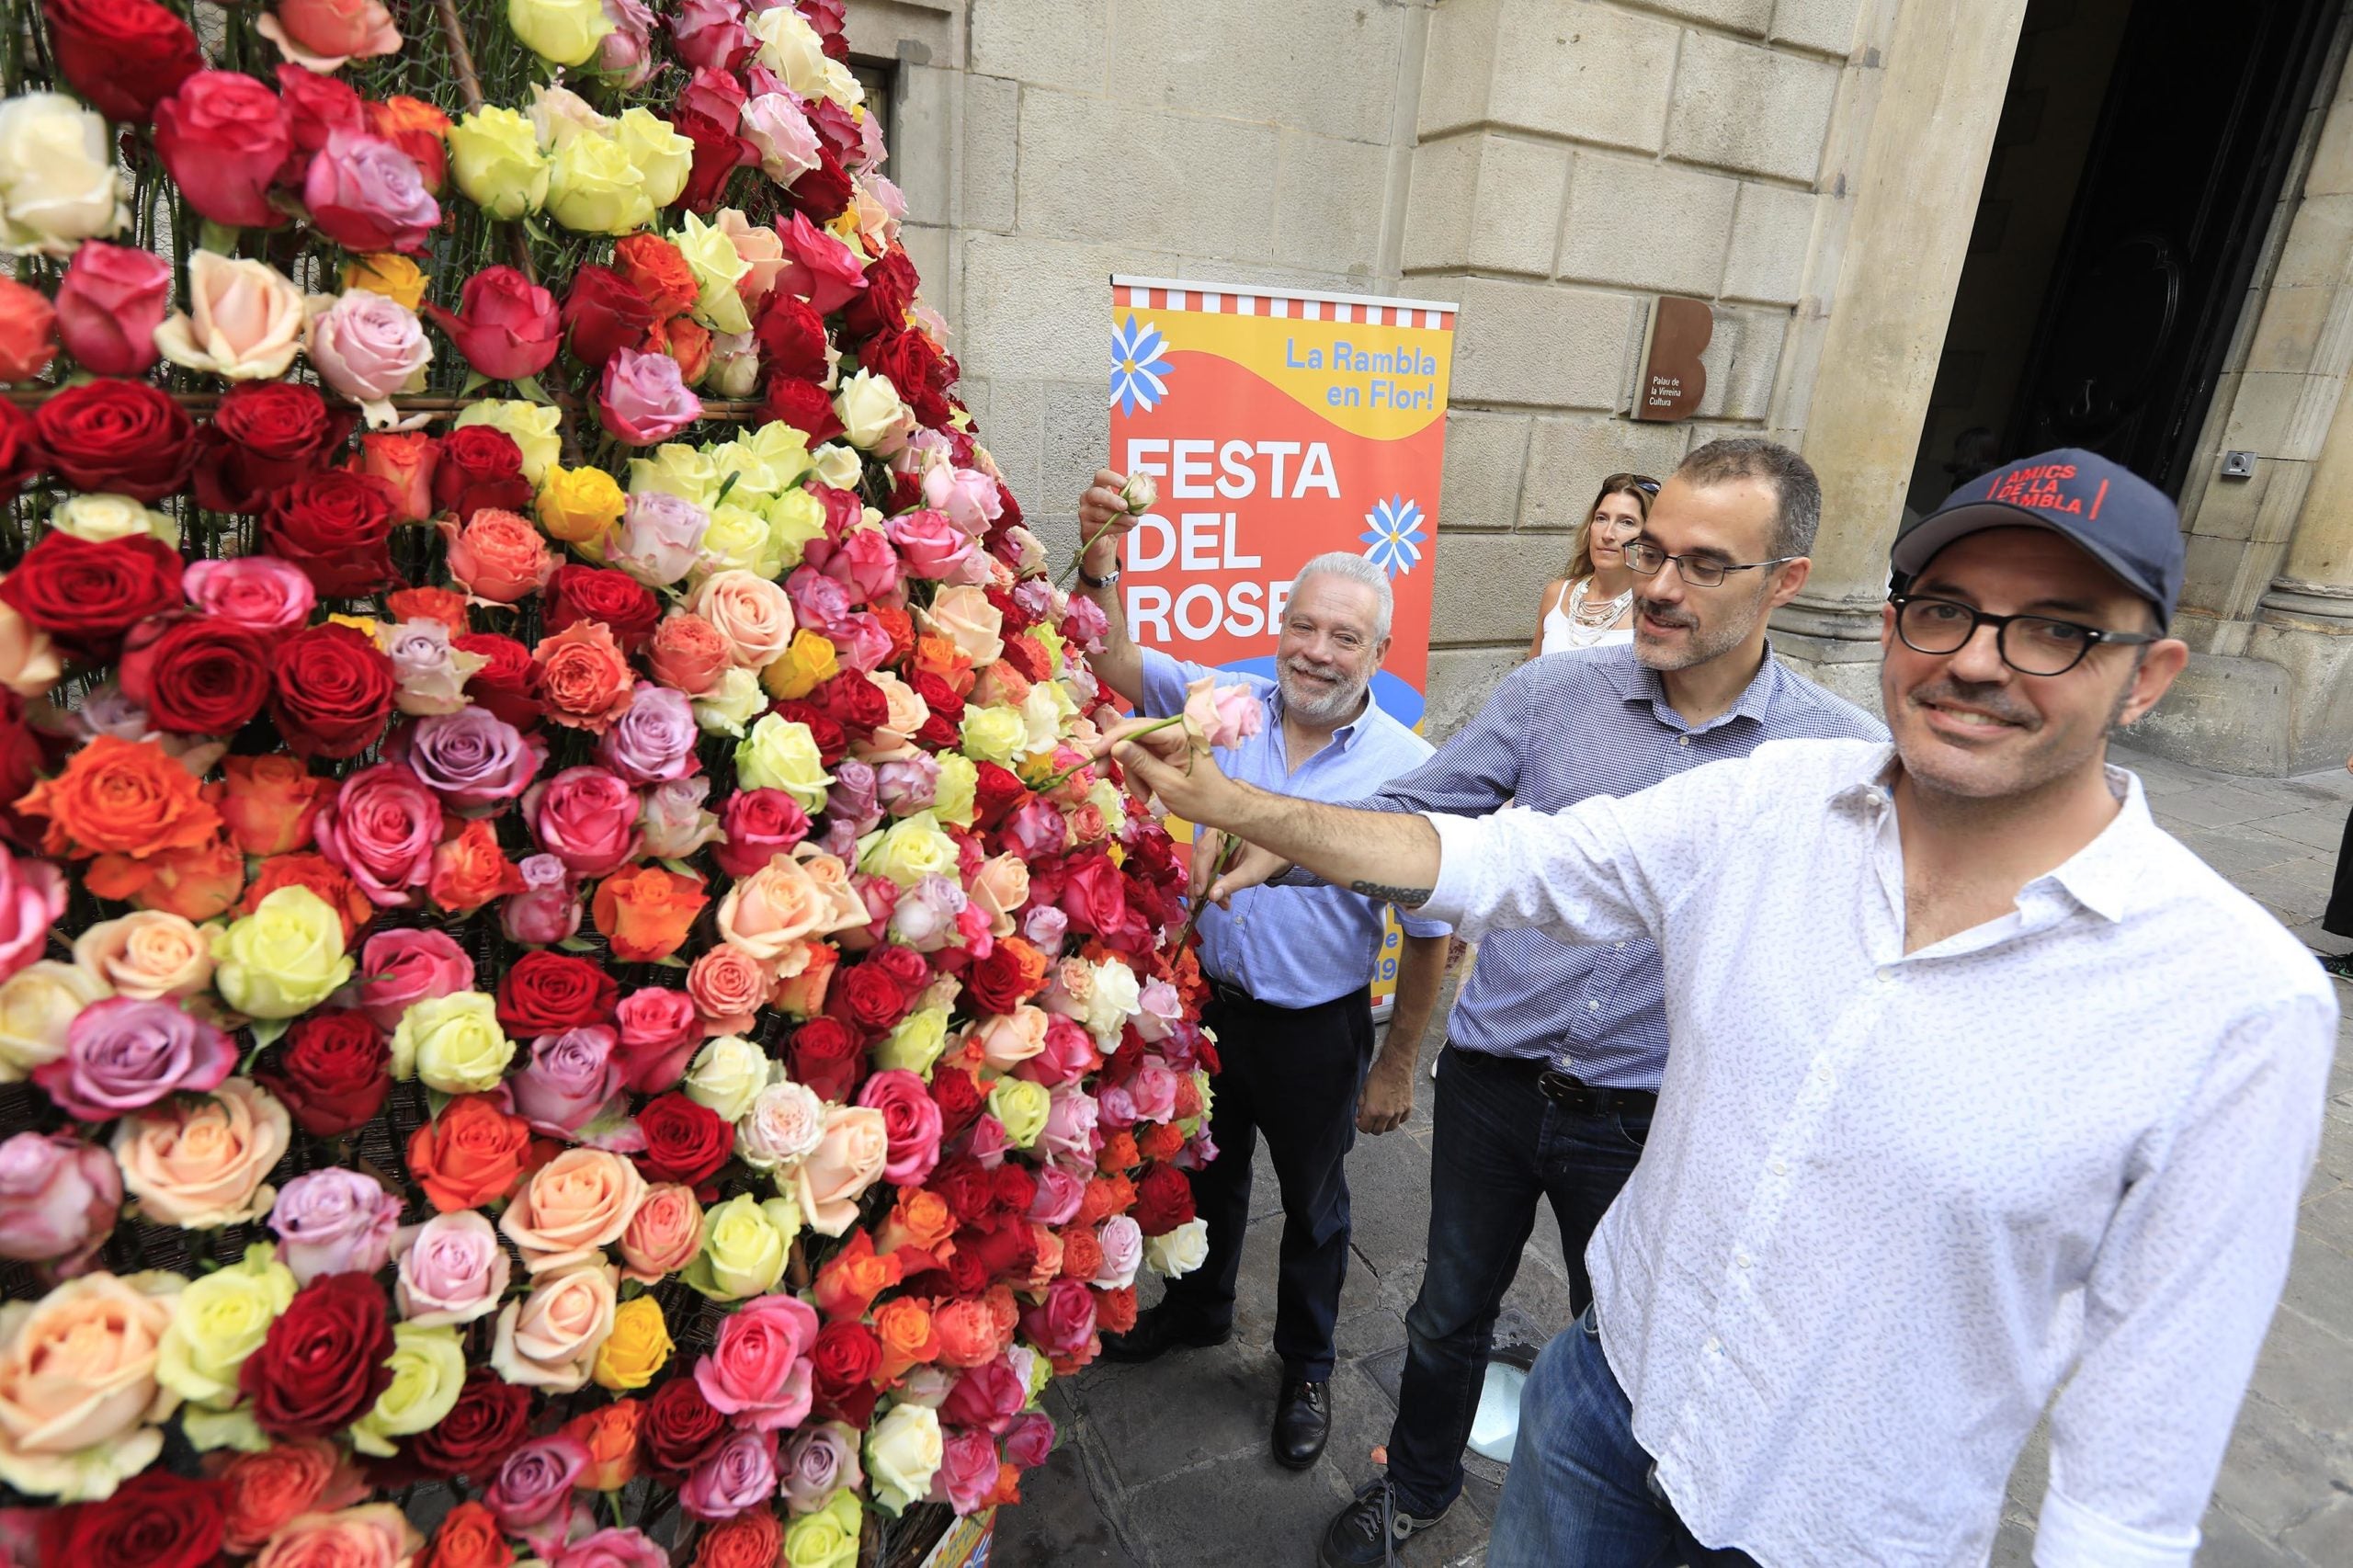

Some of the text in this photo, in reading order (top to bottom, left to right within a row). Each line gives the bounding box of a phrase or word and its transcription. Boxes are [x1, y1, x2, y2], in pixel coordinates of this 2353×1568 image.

[1287, 338, 1436, 376] La Rambla
[1651, 386, 1681, 397] la Virreina
[1653, 376, 1680, 387] Palau de
[1326, 380, 1434, 410] en Flor!
[1649, 396, 1672, 406] Cultura
[1127, 438, 1341, 499] FESTA
[2005, 464, 2077, 484] AMICS
[1996, 479, 2058, 499] DE LA
[1998, 494, 2082, 514] AMBLA
[1127, 512, 1262, 573] DEL
